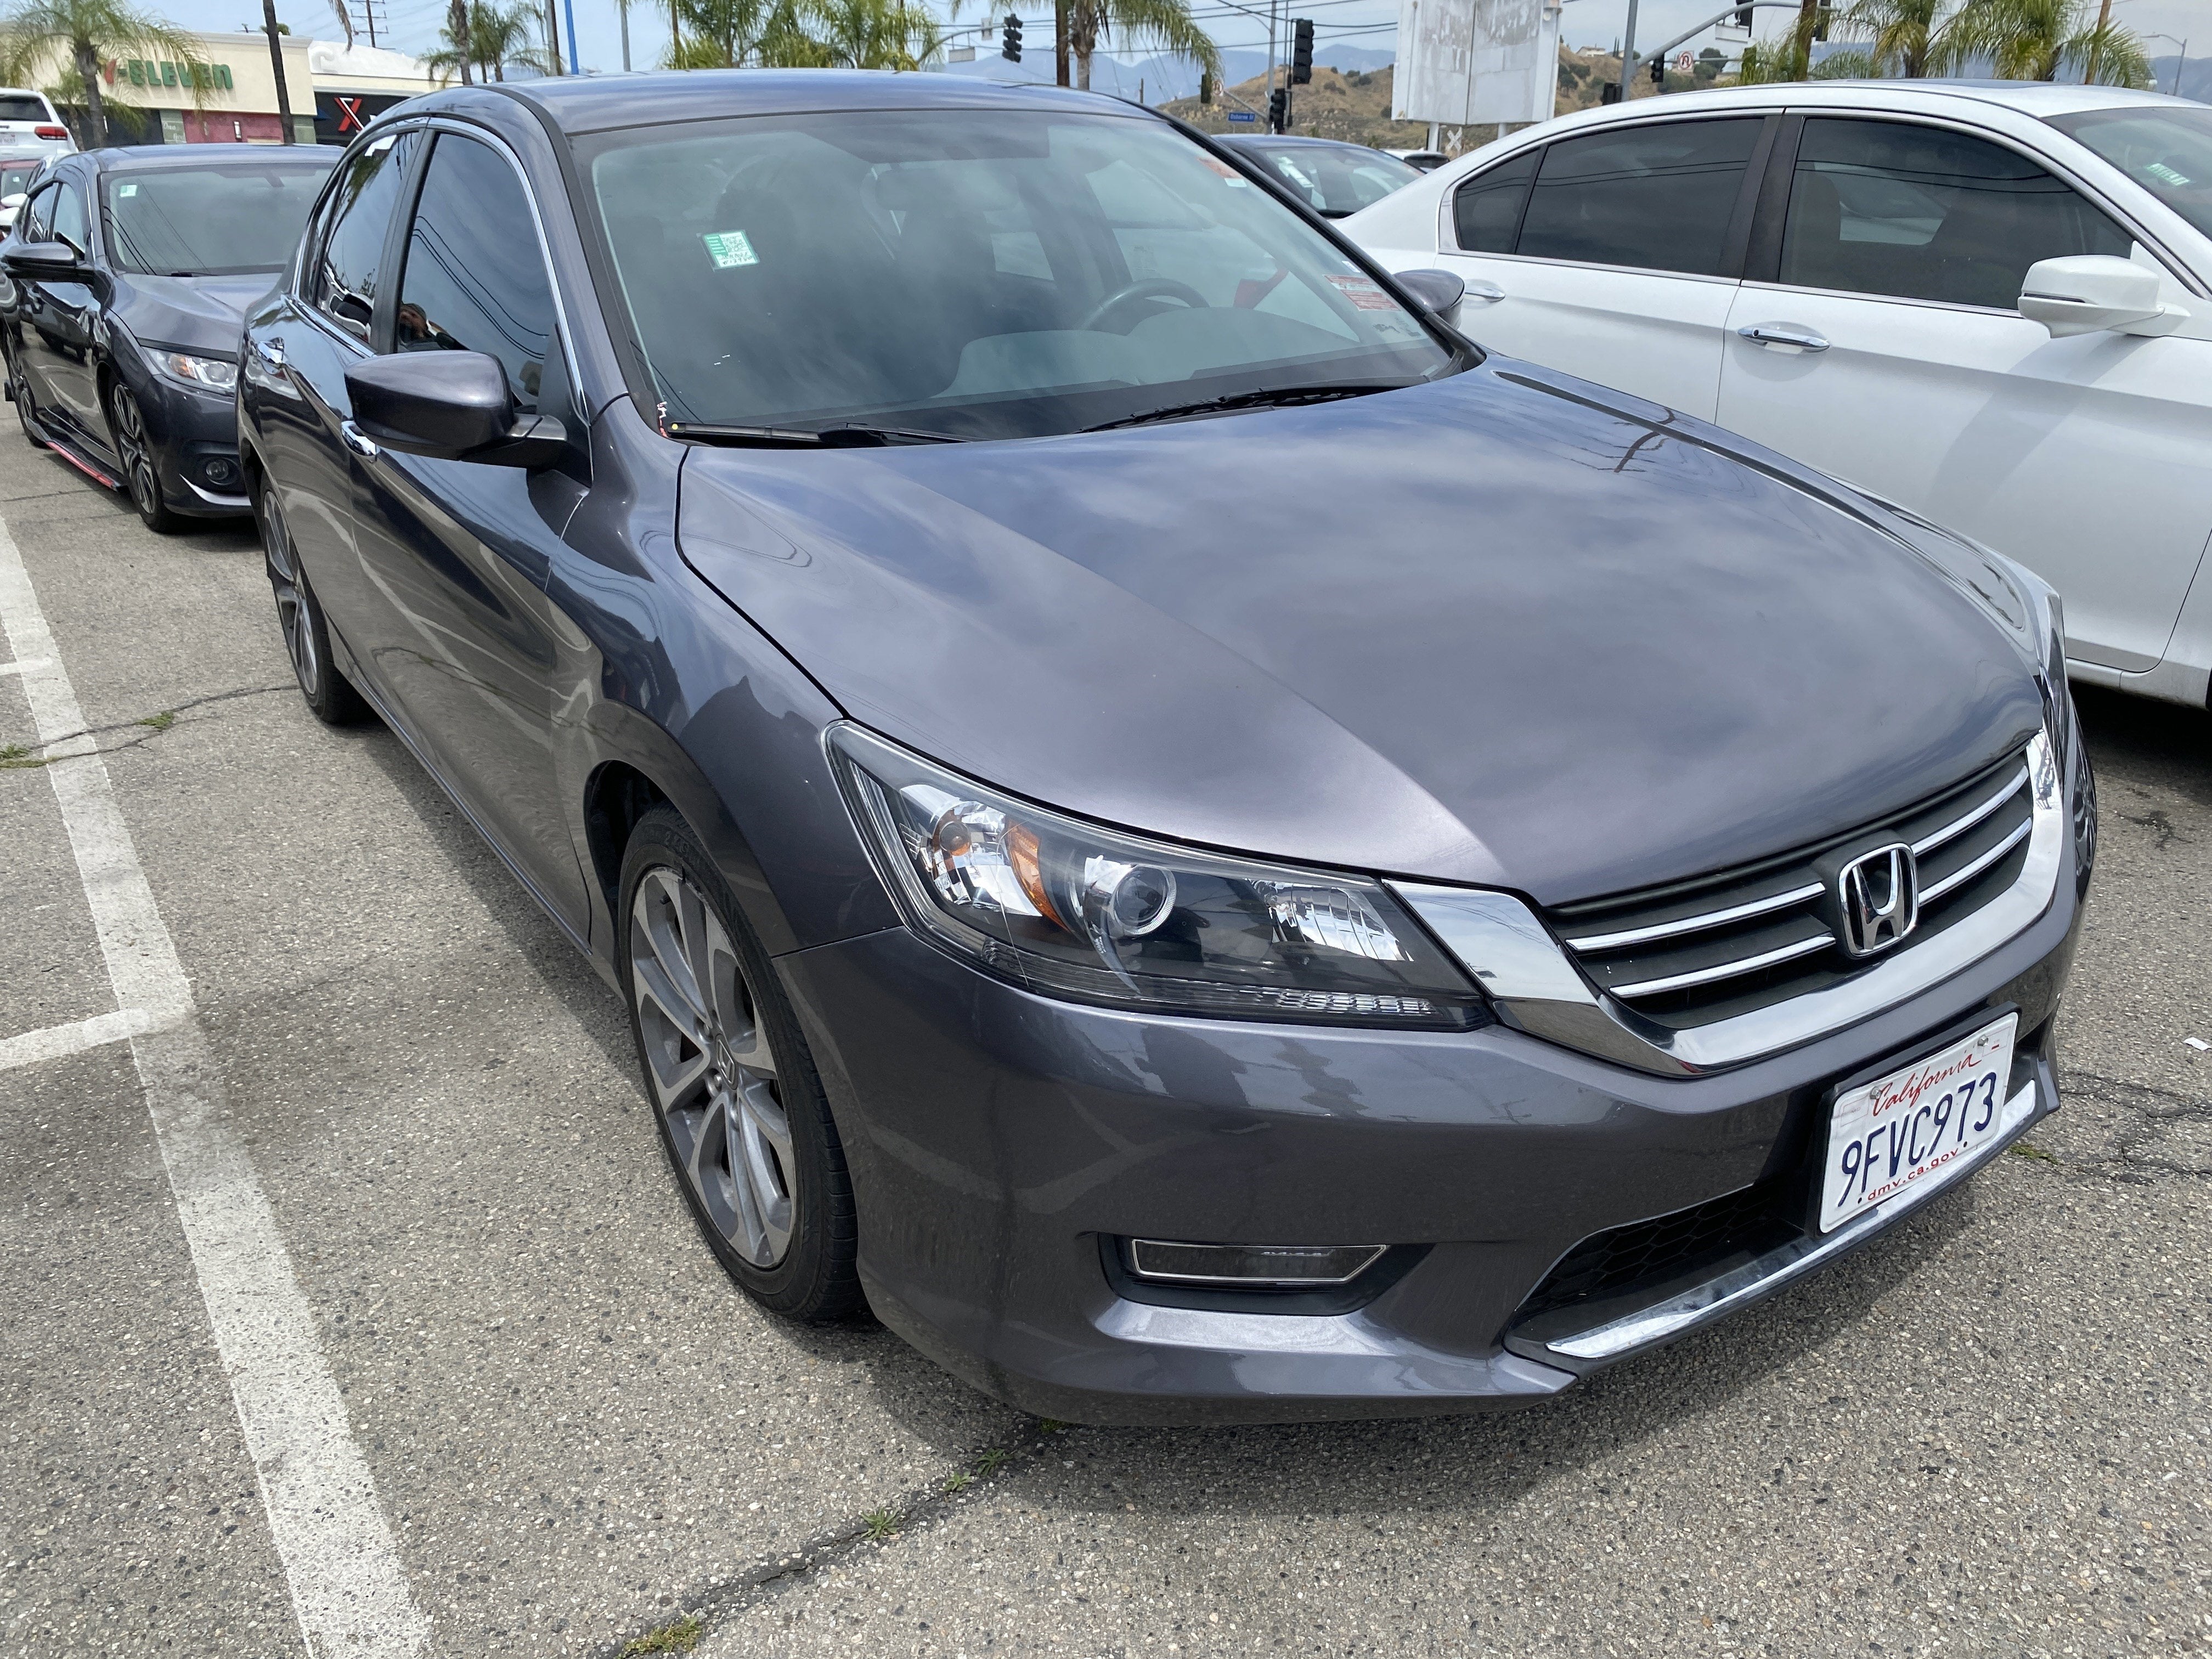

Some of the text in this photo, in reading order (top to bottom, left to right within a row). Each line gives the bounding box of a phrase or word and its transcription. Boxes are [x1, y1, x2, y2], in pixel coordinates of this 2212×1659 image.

[1872, 1050, 1982, 1117] California
[1837, 1072, 1997, 1207] 9FVC973
[1867, 1148, 1959, 1201] dmv.ca.gov
